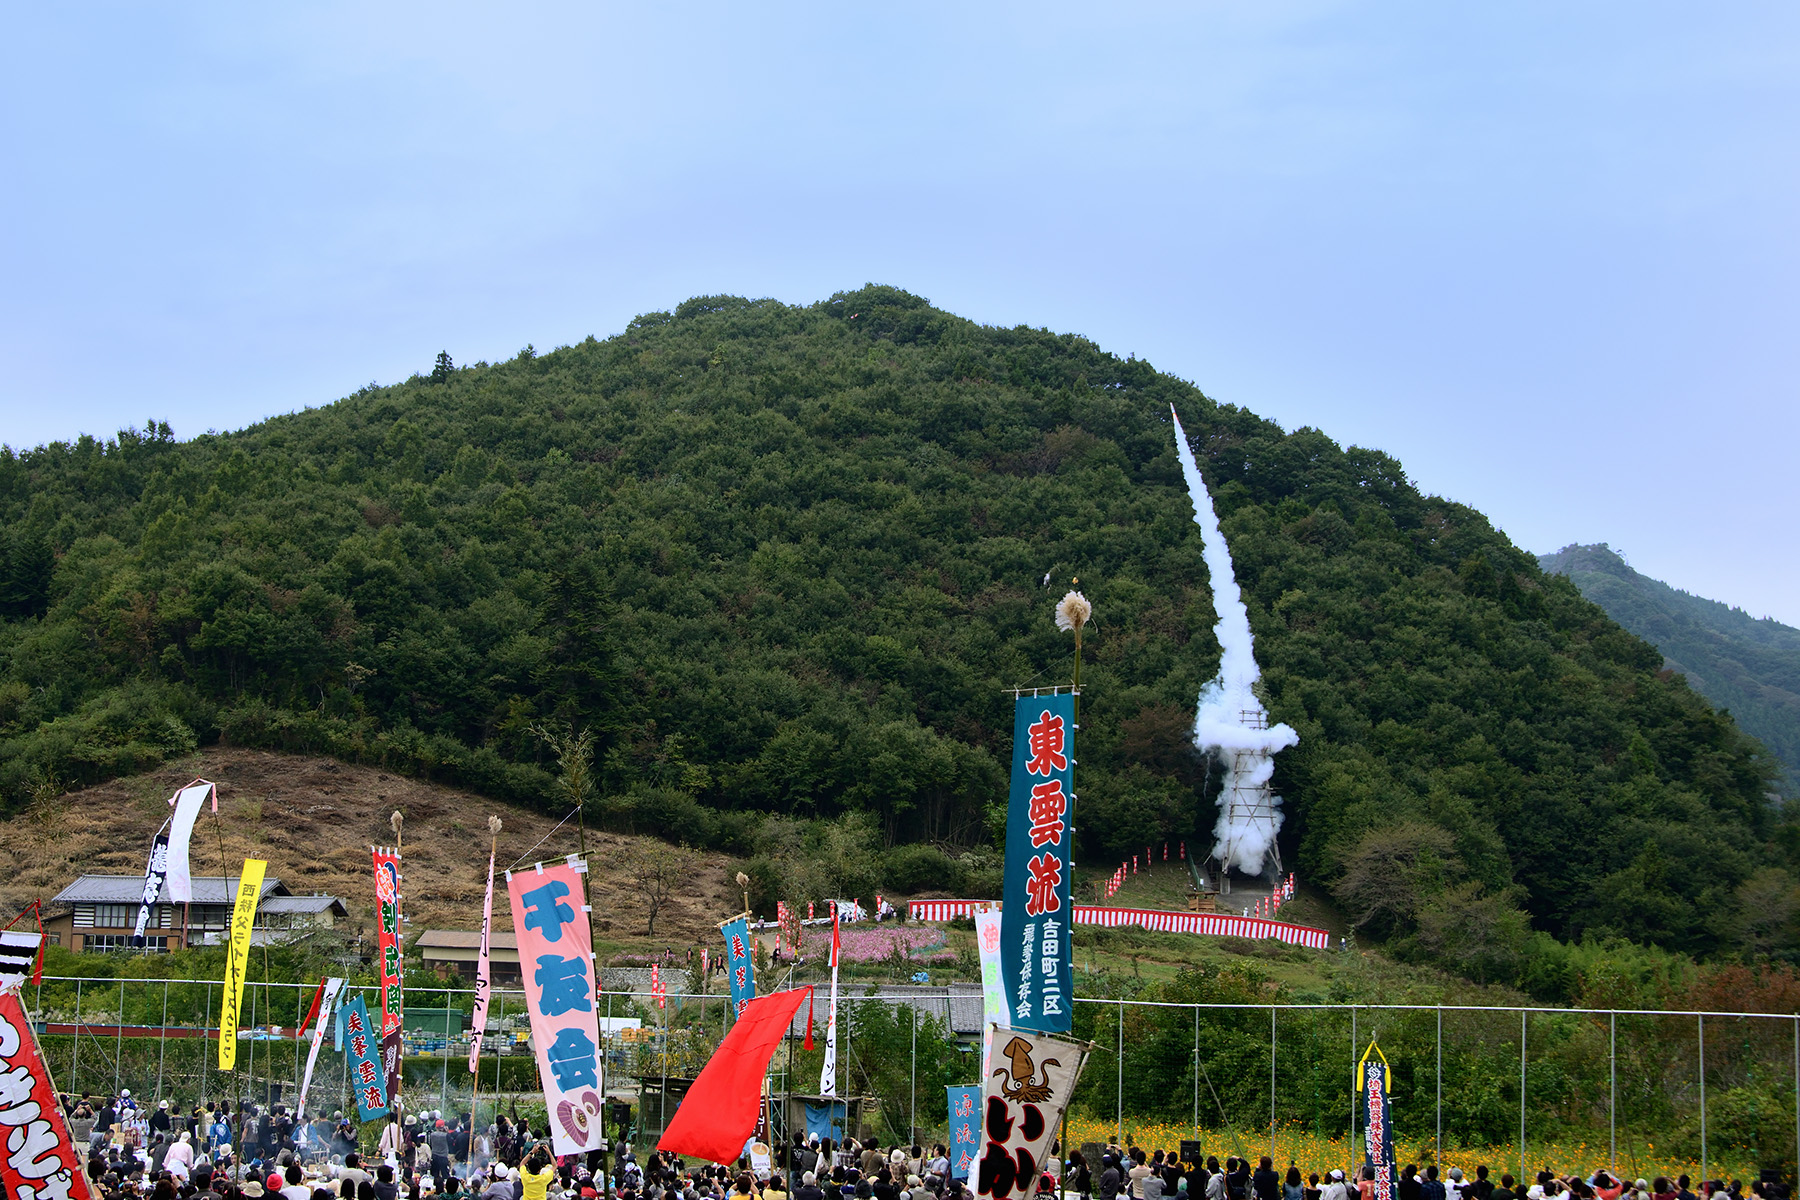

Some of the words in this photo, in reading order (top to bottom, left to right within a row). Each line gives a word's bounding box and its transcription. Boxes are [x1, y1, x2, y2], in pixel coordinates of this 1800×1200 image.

[1025, 709, 1068, 917] 東雲流
[1016, 923, 1035, 1019] 龍勢保存会
[1041, 918, 1063, 1016] 吉田町二区
[347, 1010, 385, 1110] 美峯雲流
[1367, 1078, 1385, 1165] 埼玉機器株式会社
